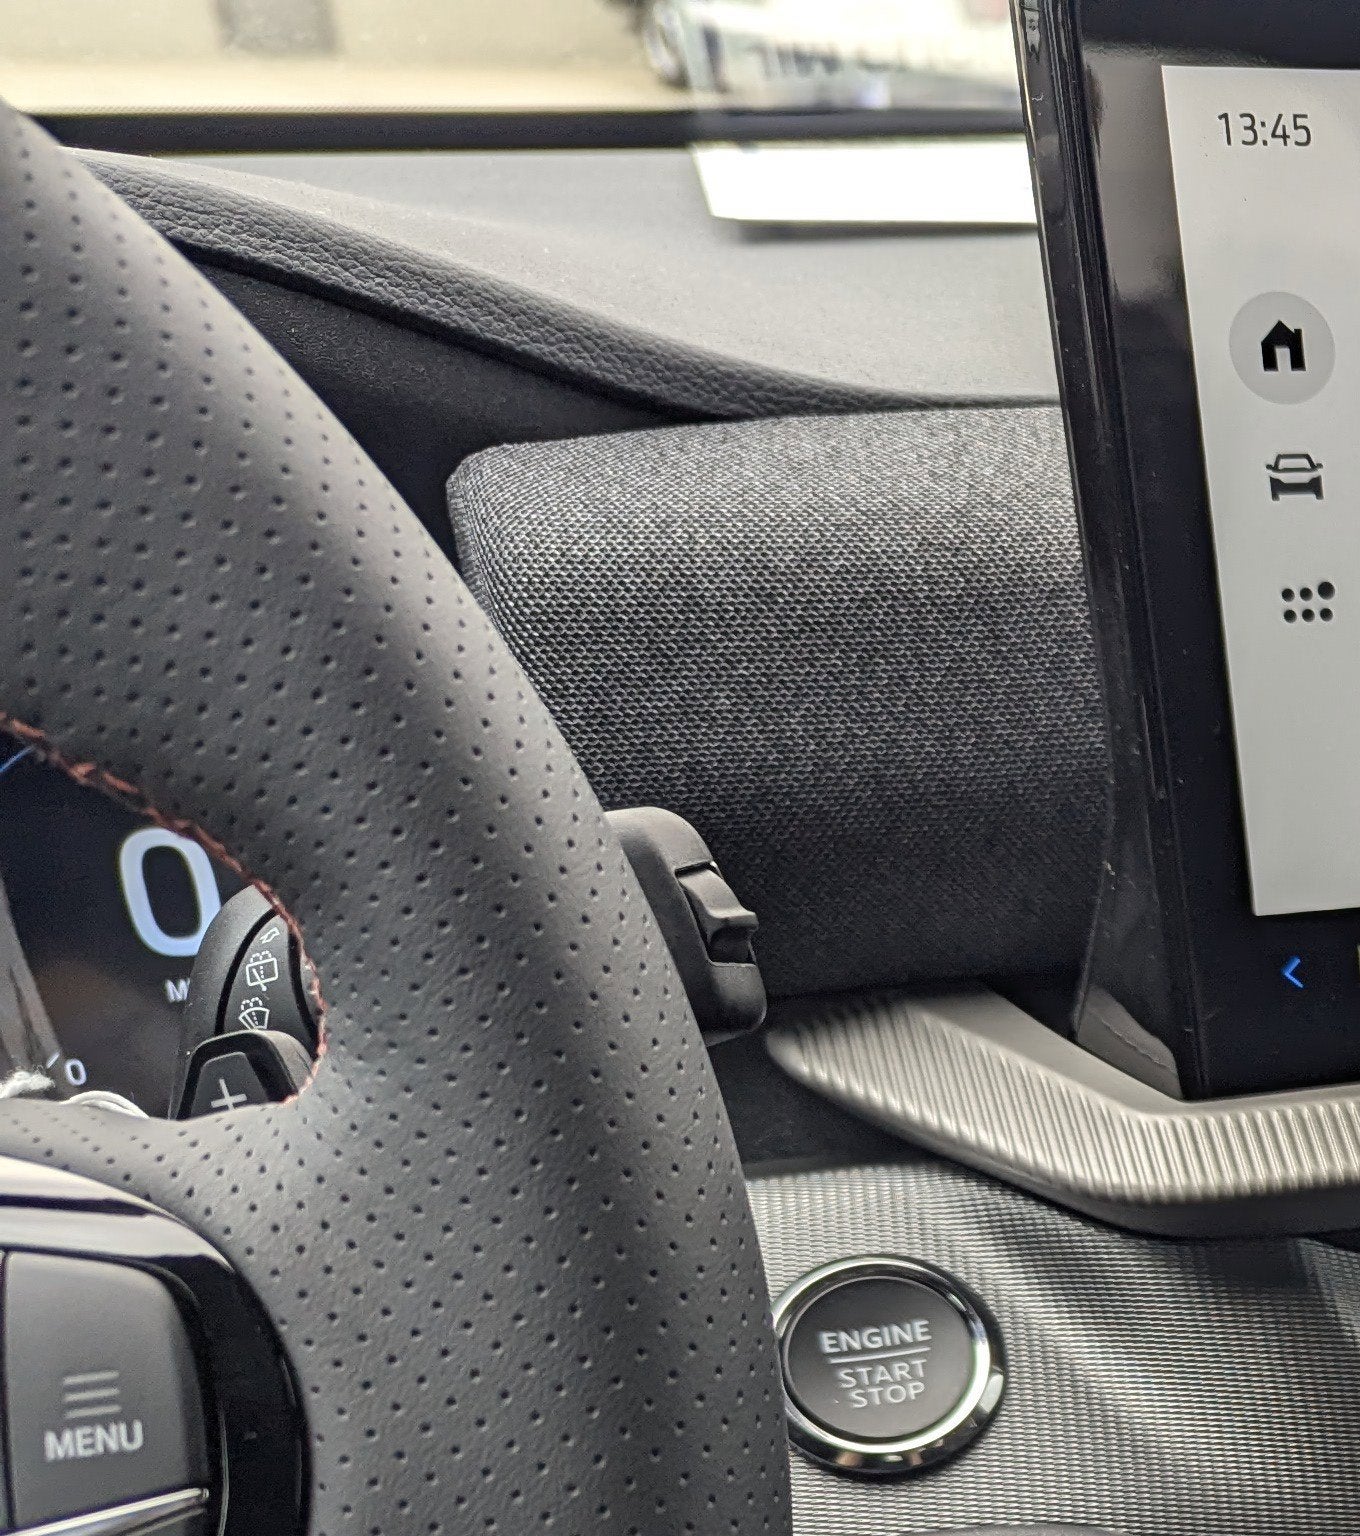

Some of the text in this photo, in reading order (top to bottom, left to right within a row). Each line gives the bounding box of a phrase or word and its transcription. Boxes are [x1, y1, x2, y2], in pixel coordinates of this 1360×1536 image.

[1218, 112, 1312, 146] 13:45
[120, 827, 221, 956] 0
[819, 1319, 932, 1353] ENGINE
[838, 1359, 927, 1388] START
[849, 1382, 925, 1408] STOP
[44, 1420, 144, 1462] MENU
